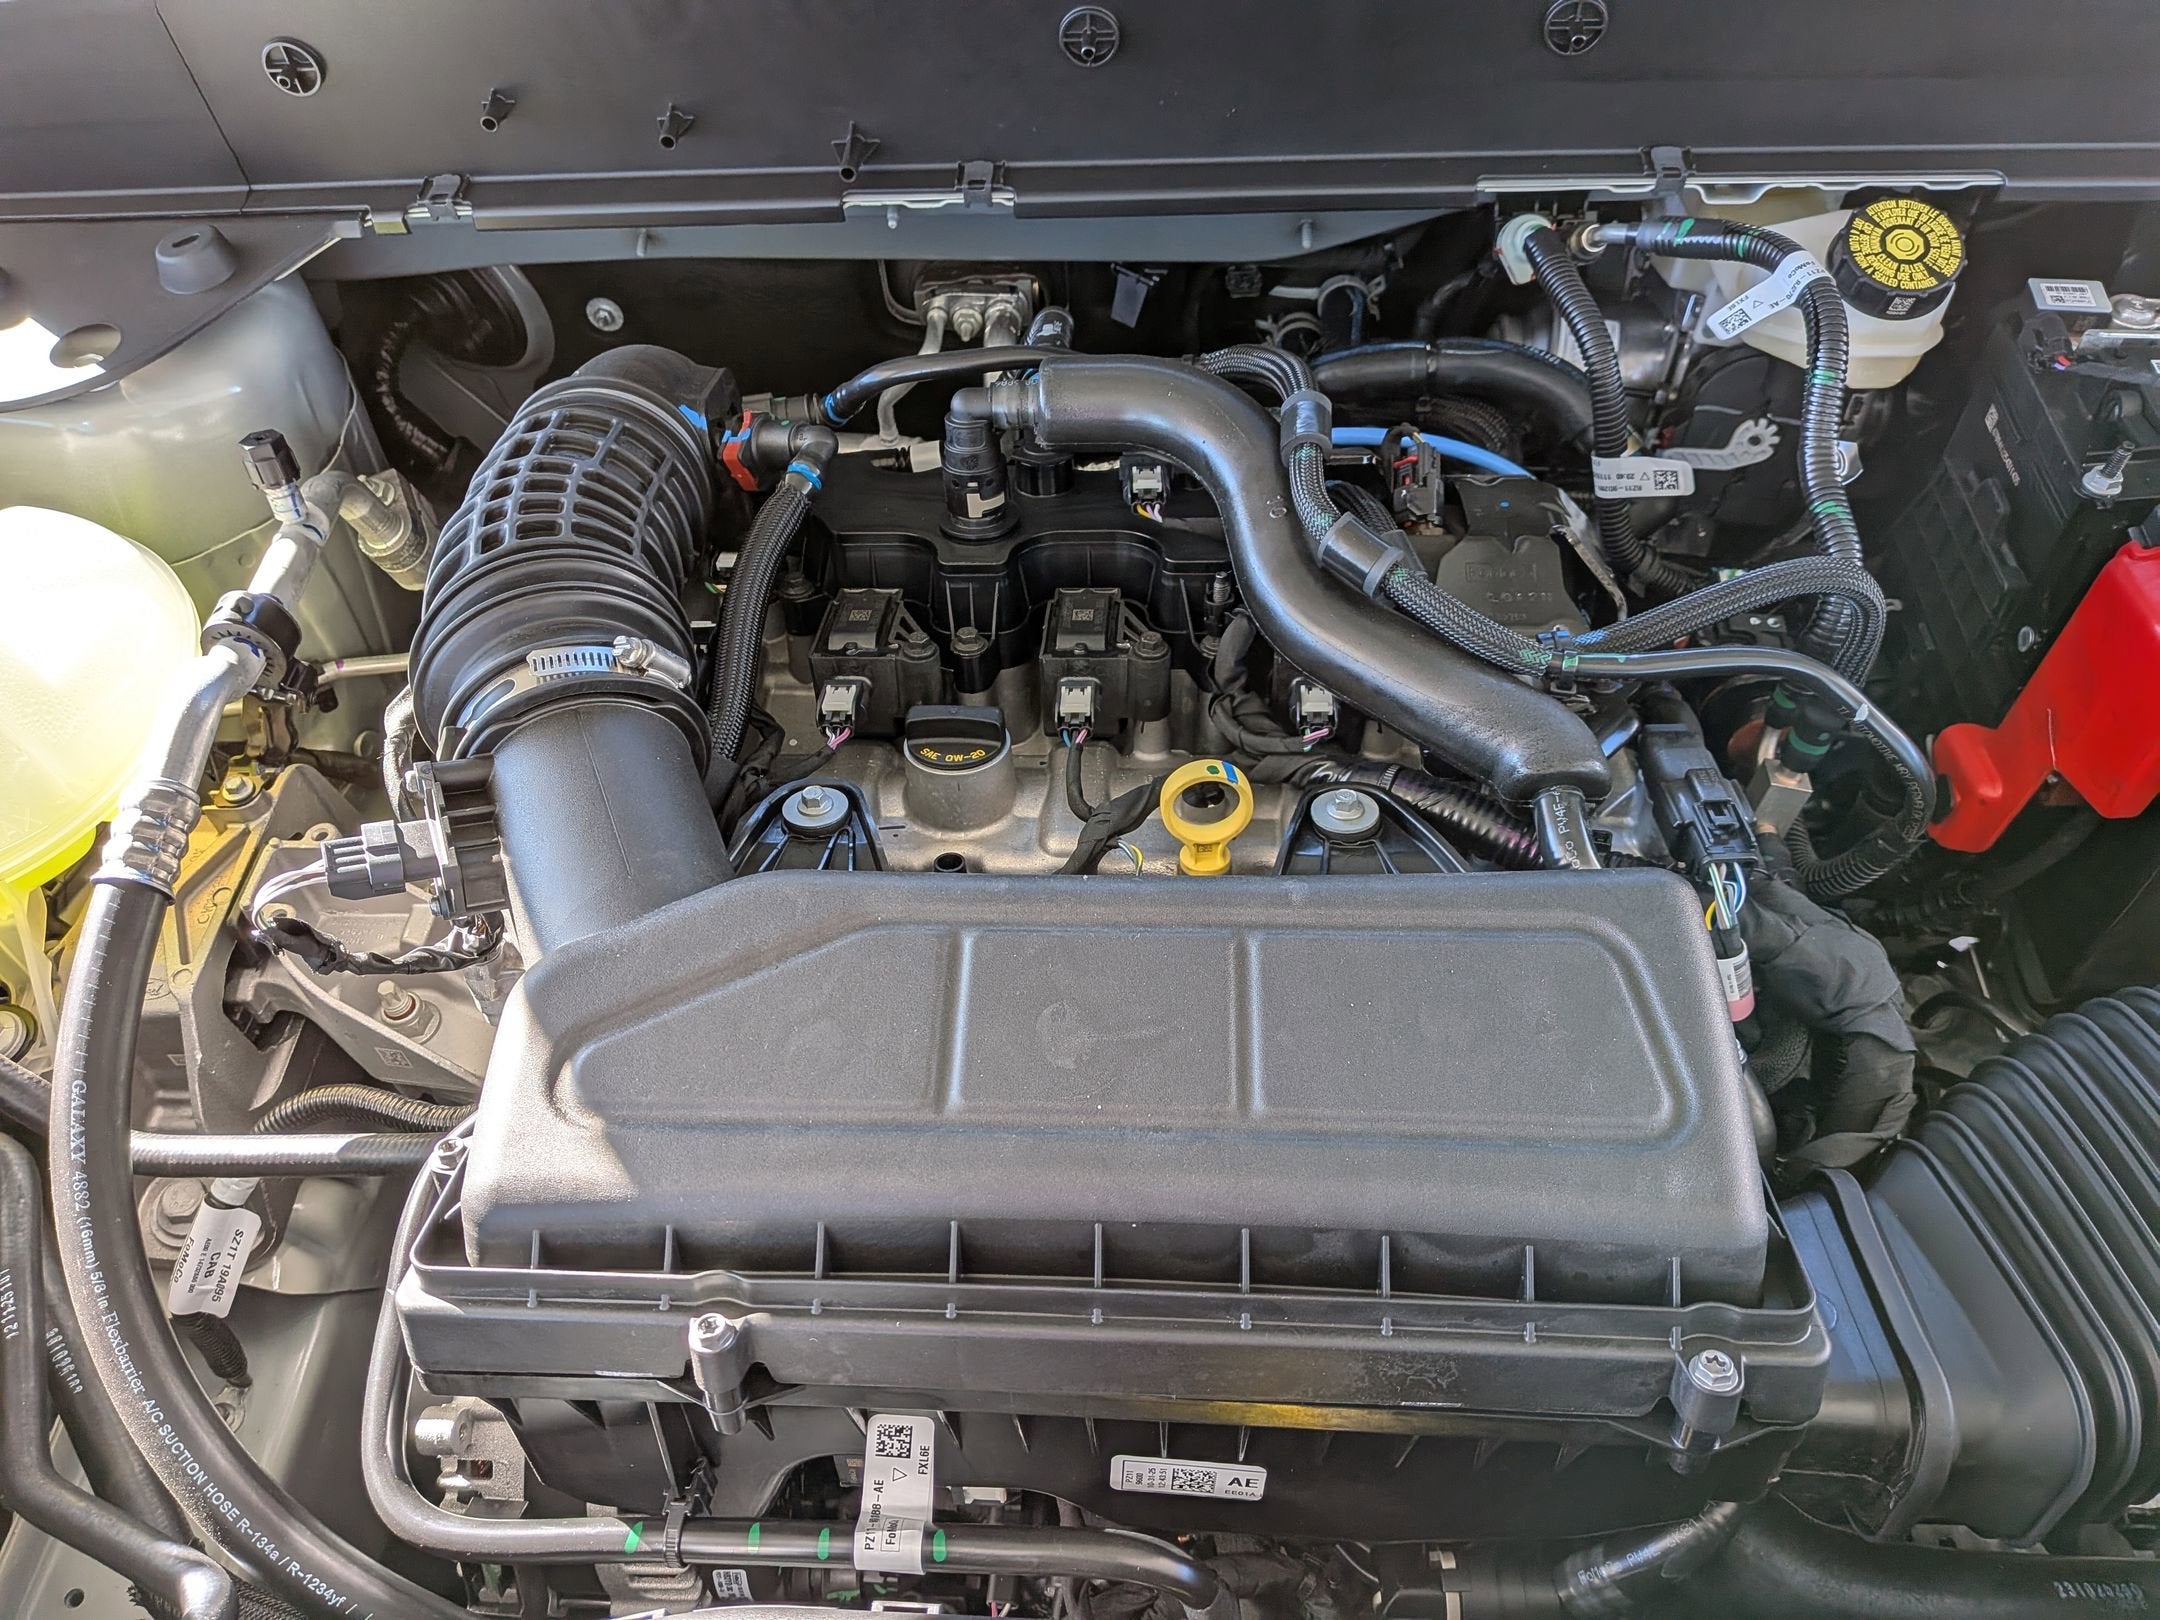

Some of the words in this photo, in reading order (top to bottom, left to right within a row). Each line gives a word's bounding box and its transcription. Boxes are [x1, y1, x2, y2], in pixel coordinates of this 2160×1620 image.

[1861, 234, 1872, 254] BEFORE
[1853, 252, 1869, 267] FROM
[1872, 271, 1897, 286] SEALED
[1900, 277, 1937, 288] CONTAINER
[1866, 255, 1894, 276] REMOVING
[1876, 253, 1898, 269] CLEAN
[1900, 262, 1925, 271] FILLER
[1912, 271, 1929, 279] ONLY
[920, 748, 941, 760] SAE
[70, 1079, 88, 1165] GALAXY
[72, 1171, 91, 1211] 4882
[76, 1216, 100, 1269] (16mm)
[226, 1228, 245, 1261] SZ1T
[173, 1236, 195, 1283] FoMoCo
[204, 1251, 221, 1279] CAB
[90, 1271, 107, 1293] 5/8
[102, 1310, 146, 1395] Flexbarrier
[142, 1399, 164, 1423] A/C
[158, 1423, 209, 1486] SUCTION
[918, 1445, 930, 1475] FXL6E
[1227, 1477, 1260, 1489] AE
[203, 1481, 241, 1522] HOSE
[236, 1517, 280, 1560] R-134a
[286, 1561, 347, 1608] R-1234yf
